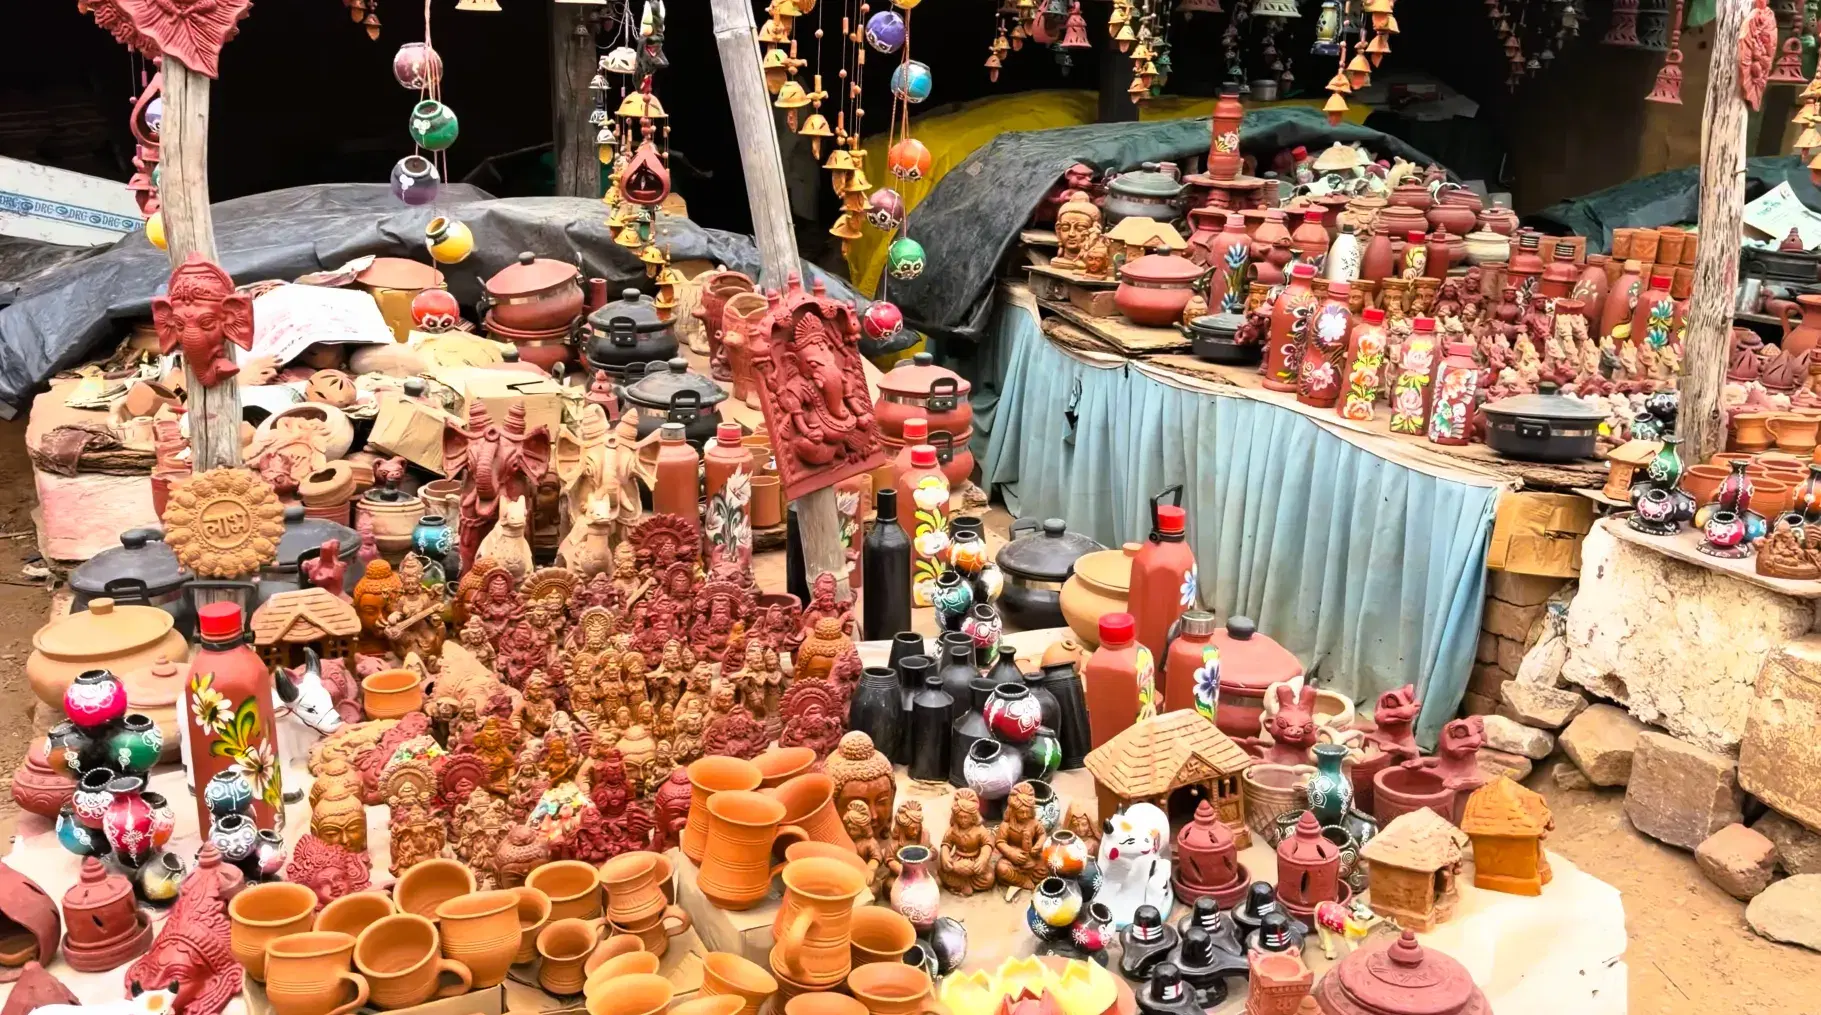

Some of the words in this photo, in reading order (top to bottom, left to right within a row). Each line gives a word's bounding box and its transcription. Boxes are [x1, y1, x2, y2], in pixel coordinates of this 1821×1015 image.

[35, 201, 55, 214] DRG
[69, 208, 88, 221] DRG
[102, 214, 120, 227] DRG
[202, 513, 249, 540] लाभ
